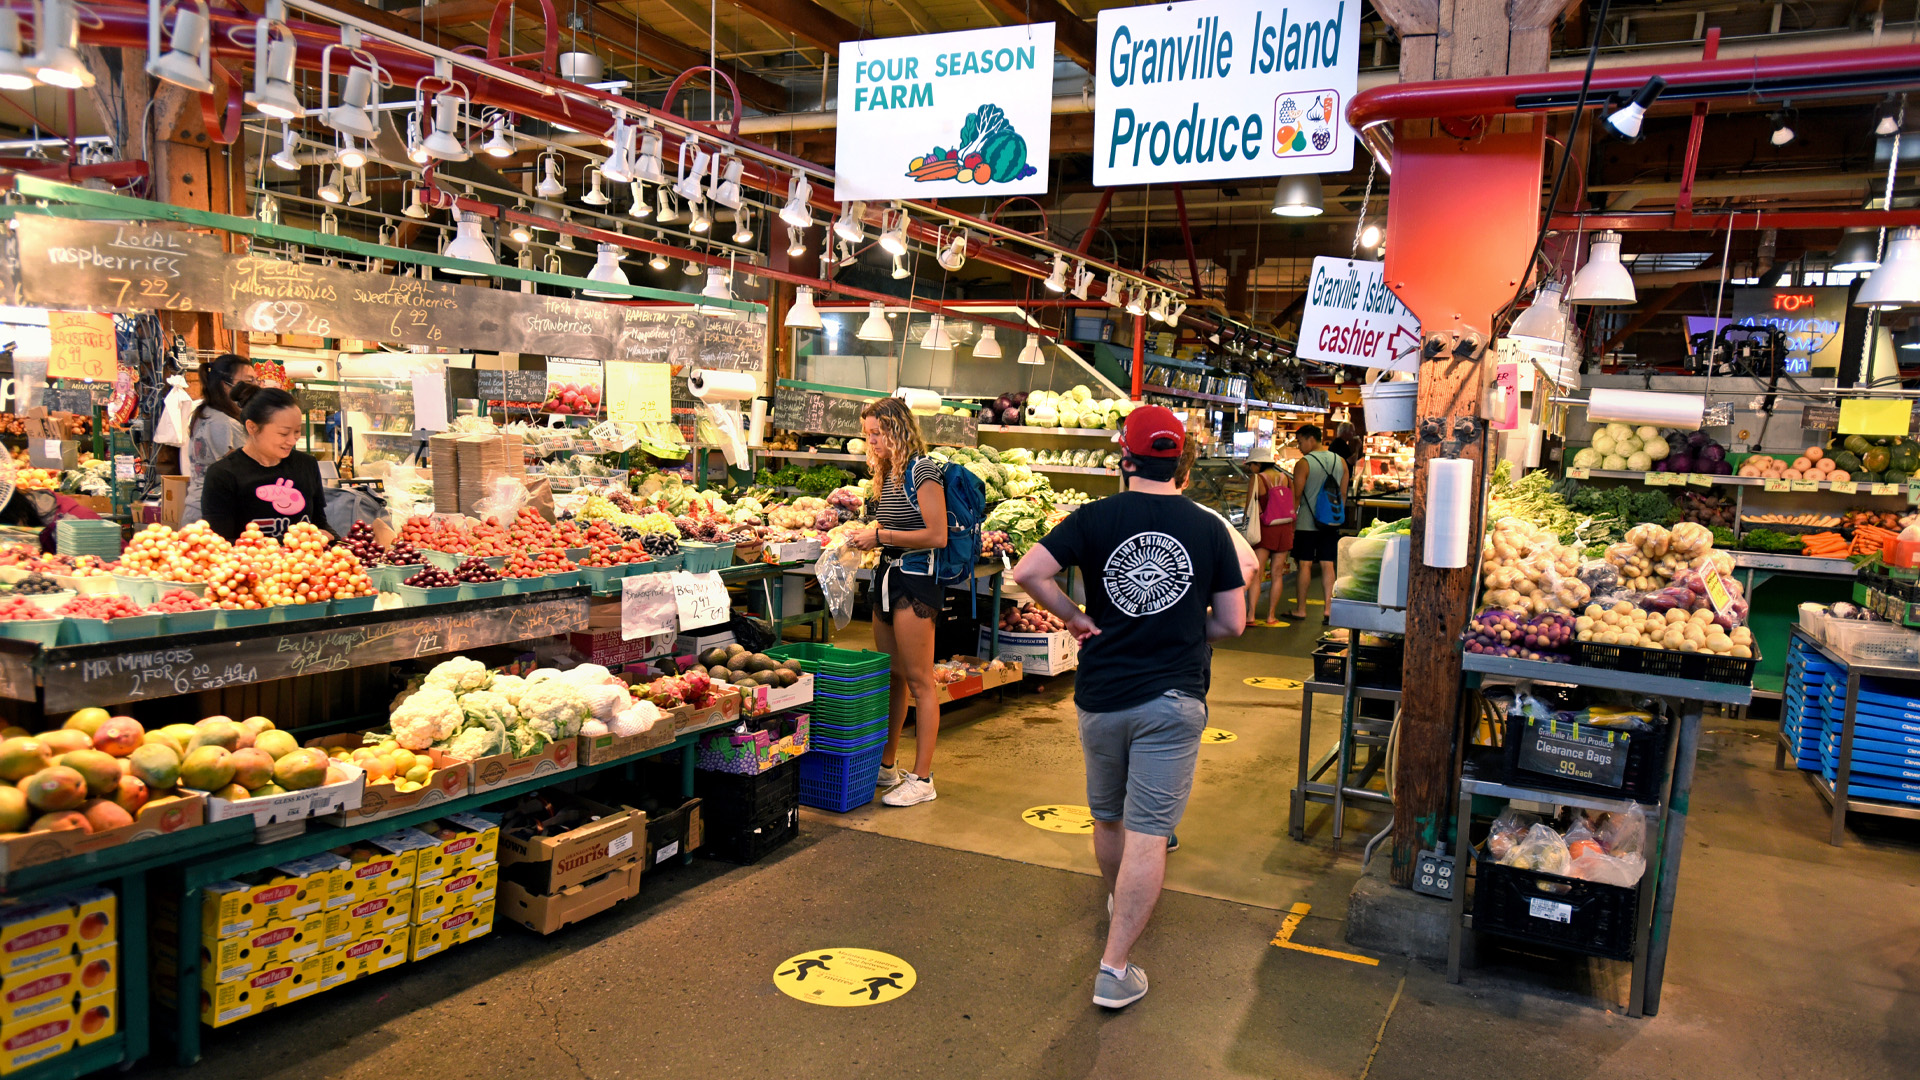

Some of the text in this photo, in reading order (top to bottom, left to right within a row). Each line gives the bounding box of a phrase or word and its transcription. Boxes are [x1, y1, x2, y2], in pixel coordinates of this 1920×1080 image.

[1110, 1, 1345, 88] Granville Island
[855, 46, 1036, 84] FOUR SEASON
[854, 82, 934, 112] FARM
[1108, 102, 1263, 168] Produce
[48, 246, 181, 278] raspberries
[1312, 266, 1361, 310] Granville
[165, 292, 193, 311] LB
[413, 294, 459, 310] cherries
[307, 316, 331, 337] LB
[426, 324, 442, 342] LB
[1318, 318, 1385, 359] cashier
[1111, 535, 1188, 570] BLIND ENTHUSIASM
[1108, 581, 1183, 614] BREWING COMPANY
[605, 630, 621, 640] TAST
[608, 639, 618, 648] BIG
[619, 644, 630, 654] BIG
[83, 648, 194, 682] MIX MANGOES
[604, 654, 626, 665] TASTE
[130, 674, 144, 696] 2
[142, 664, 174, 682] FOR
[1587, 736, 1616, 749] Produce
[1536, 740, 1612, 766] Clearance Bags
[447, 839, 472, 852] Sweet Pacific
[360, 862, 388, 876] Sweet Pacific
[448, 876, 473, 891] Sweet Pacific
[258, 887, 291, 902] Sweet Pacific
[356, 900, 384, 915] Sweet Pacific
[446, 913, 470, 928] Sweet Pacific
[256, 930, 290, 945] Sweet Pacific
[350, 940, 379, 956] Sweet Pacific
[255, 970, 288, 986] Sweet Pacific
[824, 974, 854, 986] metres
